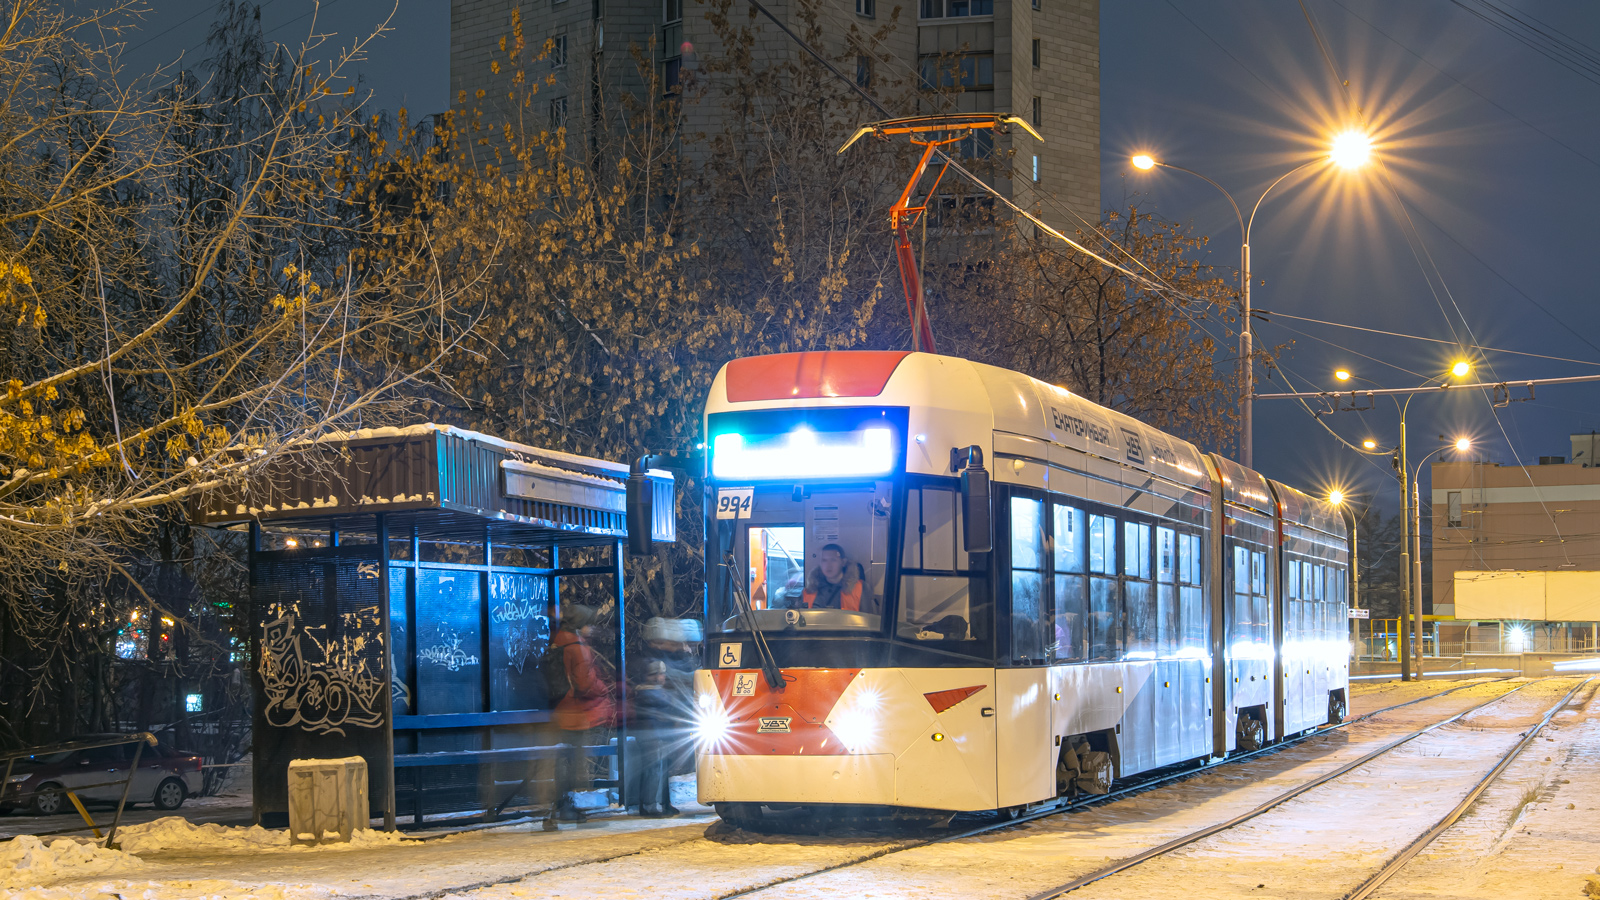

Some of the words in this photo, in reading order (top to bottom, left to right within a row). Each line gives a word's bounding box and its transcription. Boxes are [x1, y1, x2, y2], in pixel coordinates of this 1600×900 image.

[1051, 406, 1111, 445] ЕКАТЕРИНБУРГ
[719, 496, 751, 512] 994
[762, 719, 788, 728] УВЗ
